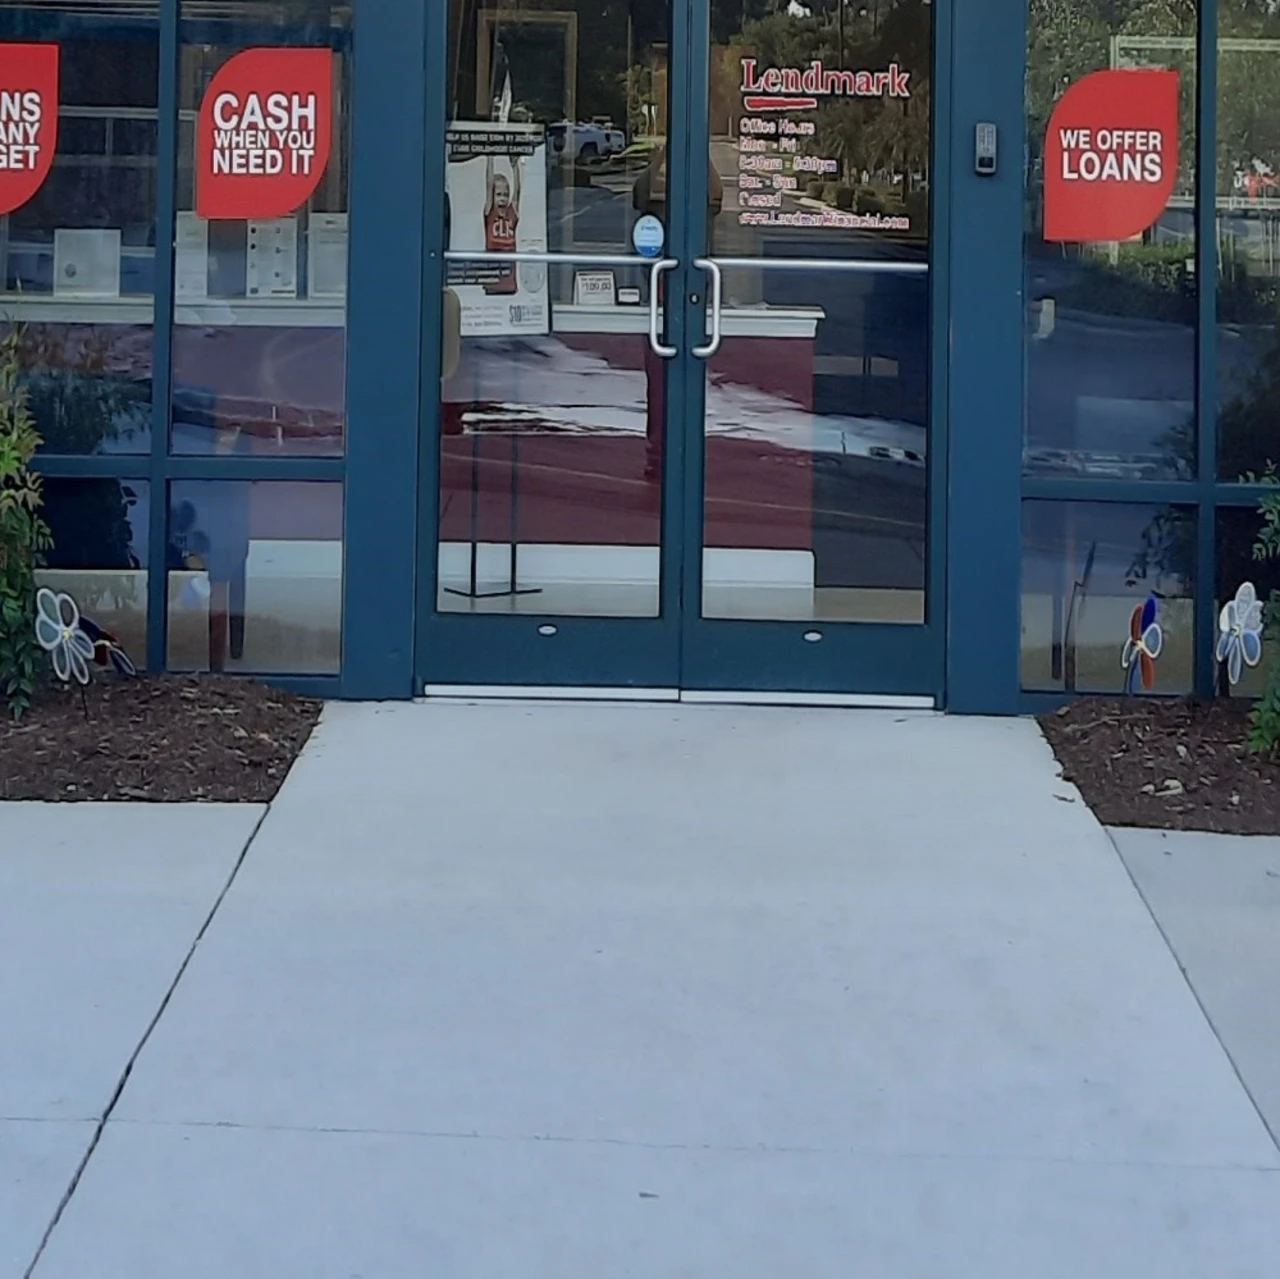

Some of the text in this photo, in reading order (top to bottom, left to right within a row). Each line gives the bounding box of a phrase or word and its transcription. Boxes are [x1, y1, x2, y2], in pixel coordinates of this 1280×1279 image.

[740, 58, 911, 97] Lendmark
[213, 93, 316, 131] CASH
[213, 130, 315, 150] WHEN YOU
[1059, 128, 1163, 152] WE OFFER
[213, 149, 315, 175] NEED IT
[1061, 151, 1163, 183] LOANS
